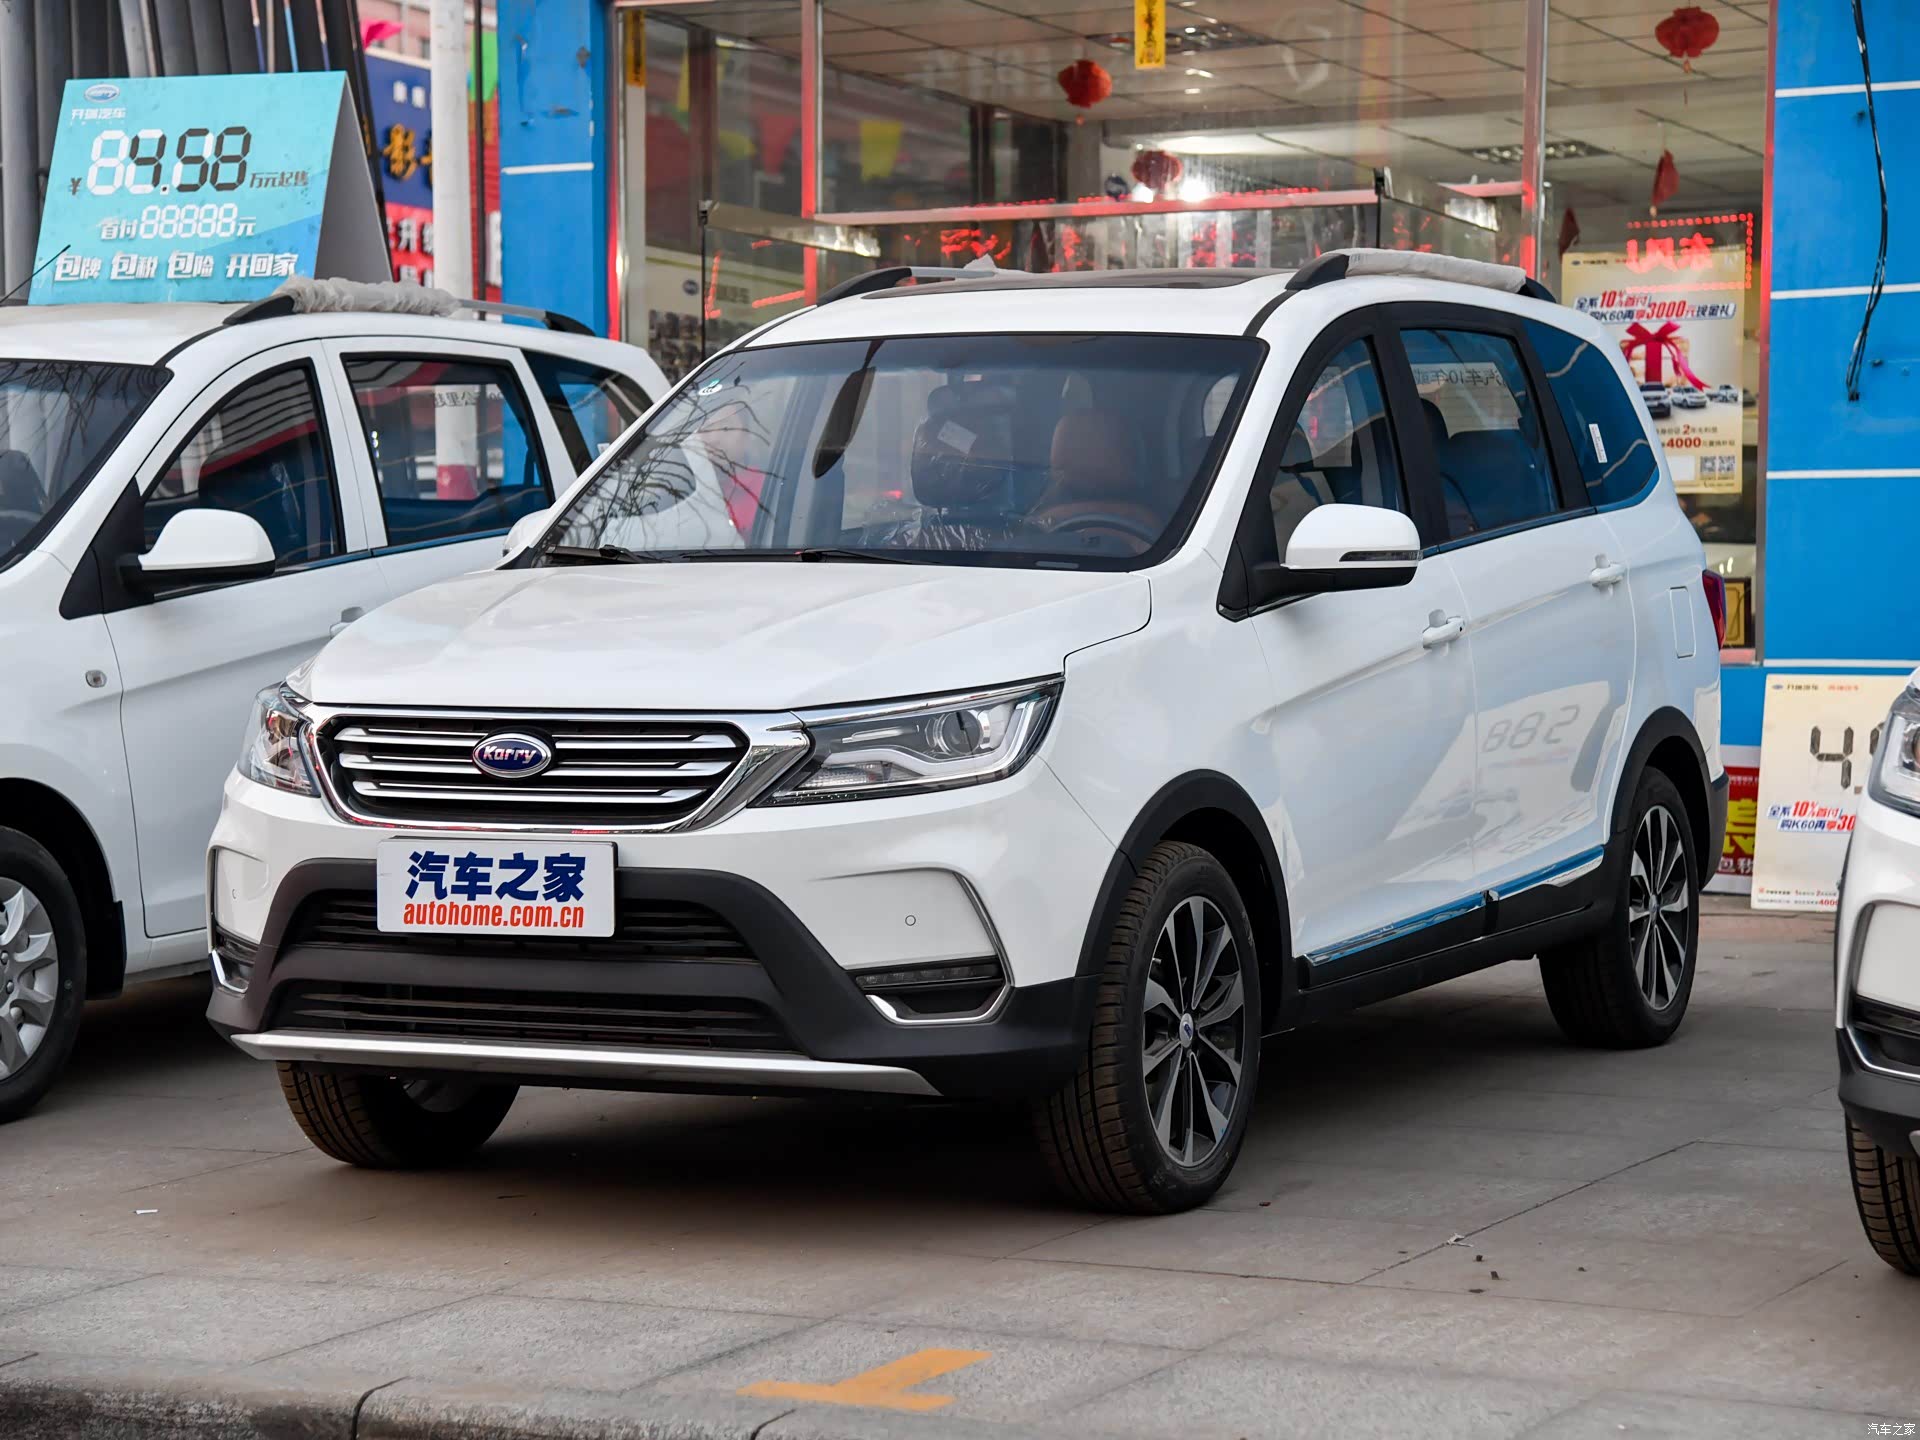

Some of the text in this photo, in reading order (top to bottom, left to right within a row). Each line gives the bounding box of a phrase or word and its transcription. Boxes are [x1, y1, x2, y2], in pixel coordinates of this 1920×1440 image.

[54, 251, 101, 281] 包牌
[167, 249, 214, 279] 包险
[226, 252, 299, 279] 开回家
[482, 743, 537, 764] Karry
[405, 851, 586, 902] 汽车之家
[403, 901, 584, 928] autohome.com.cn
